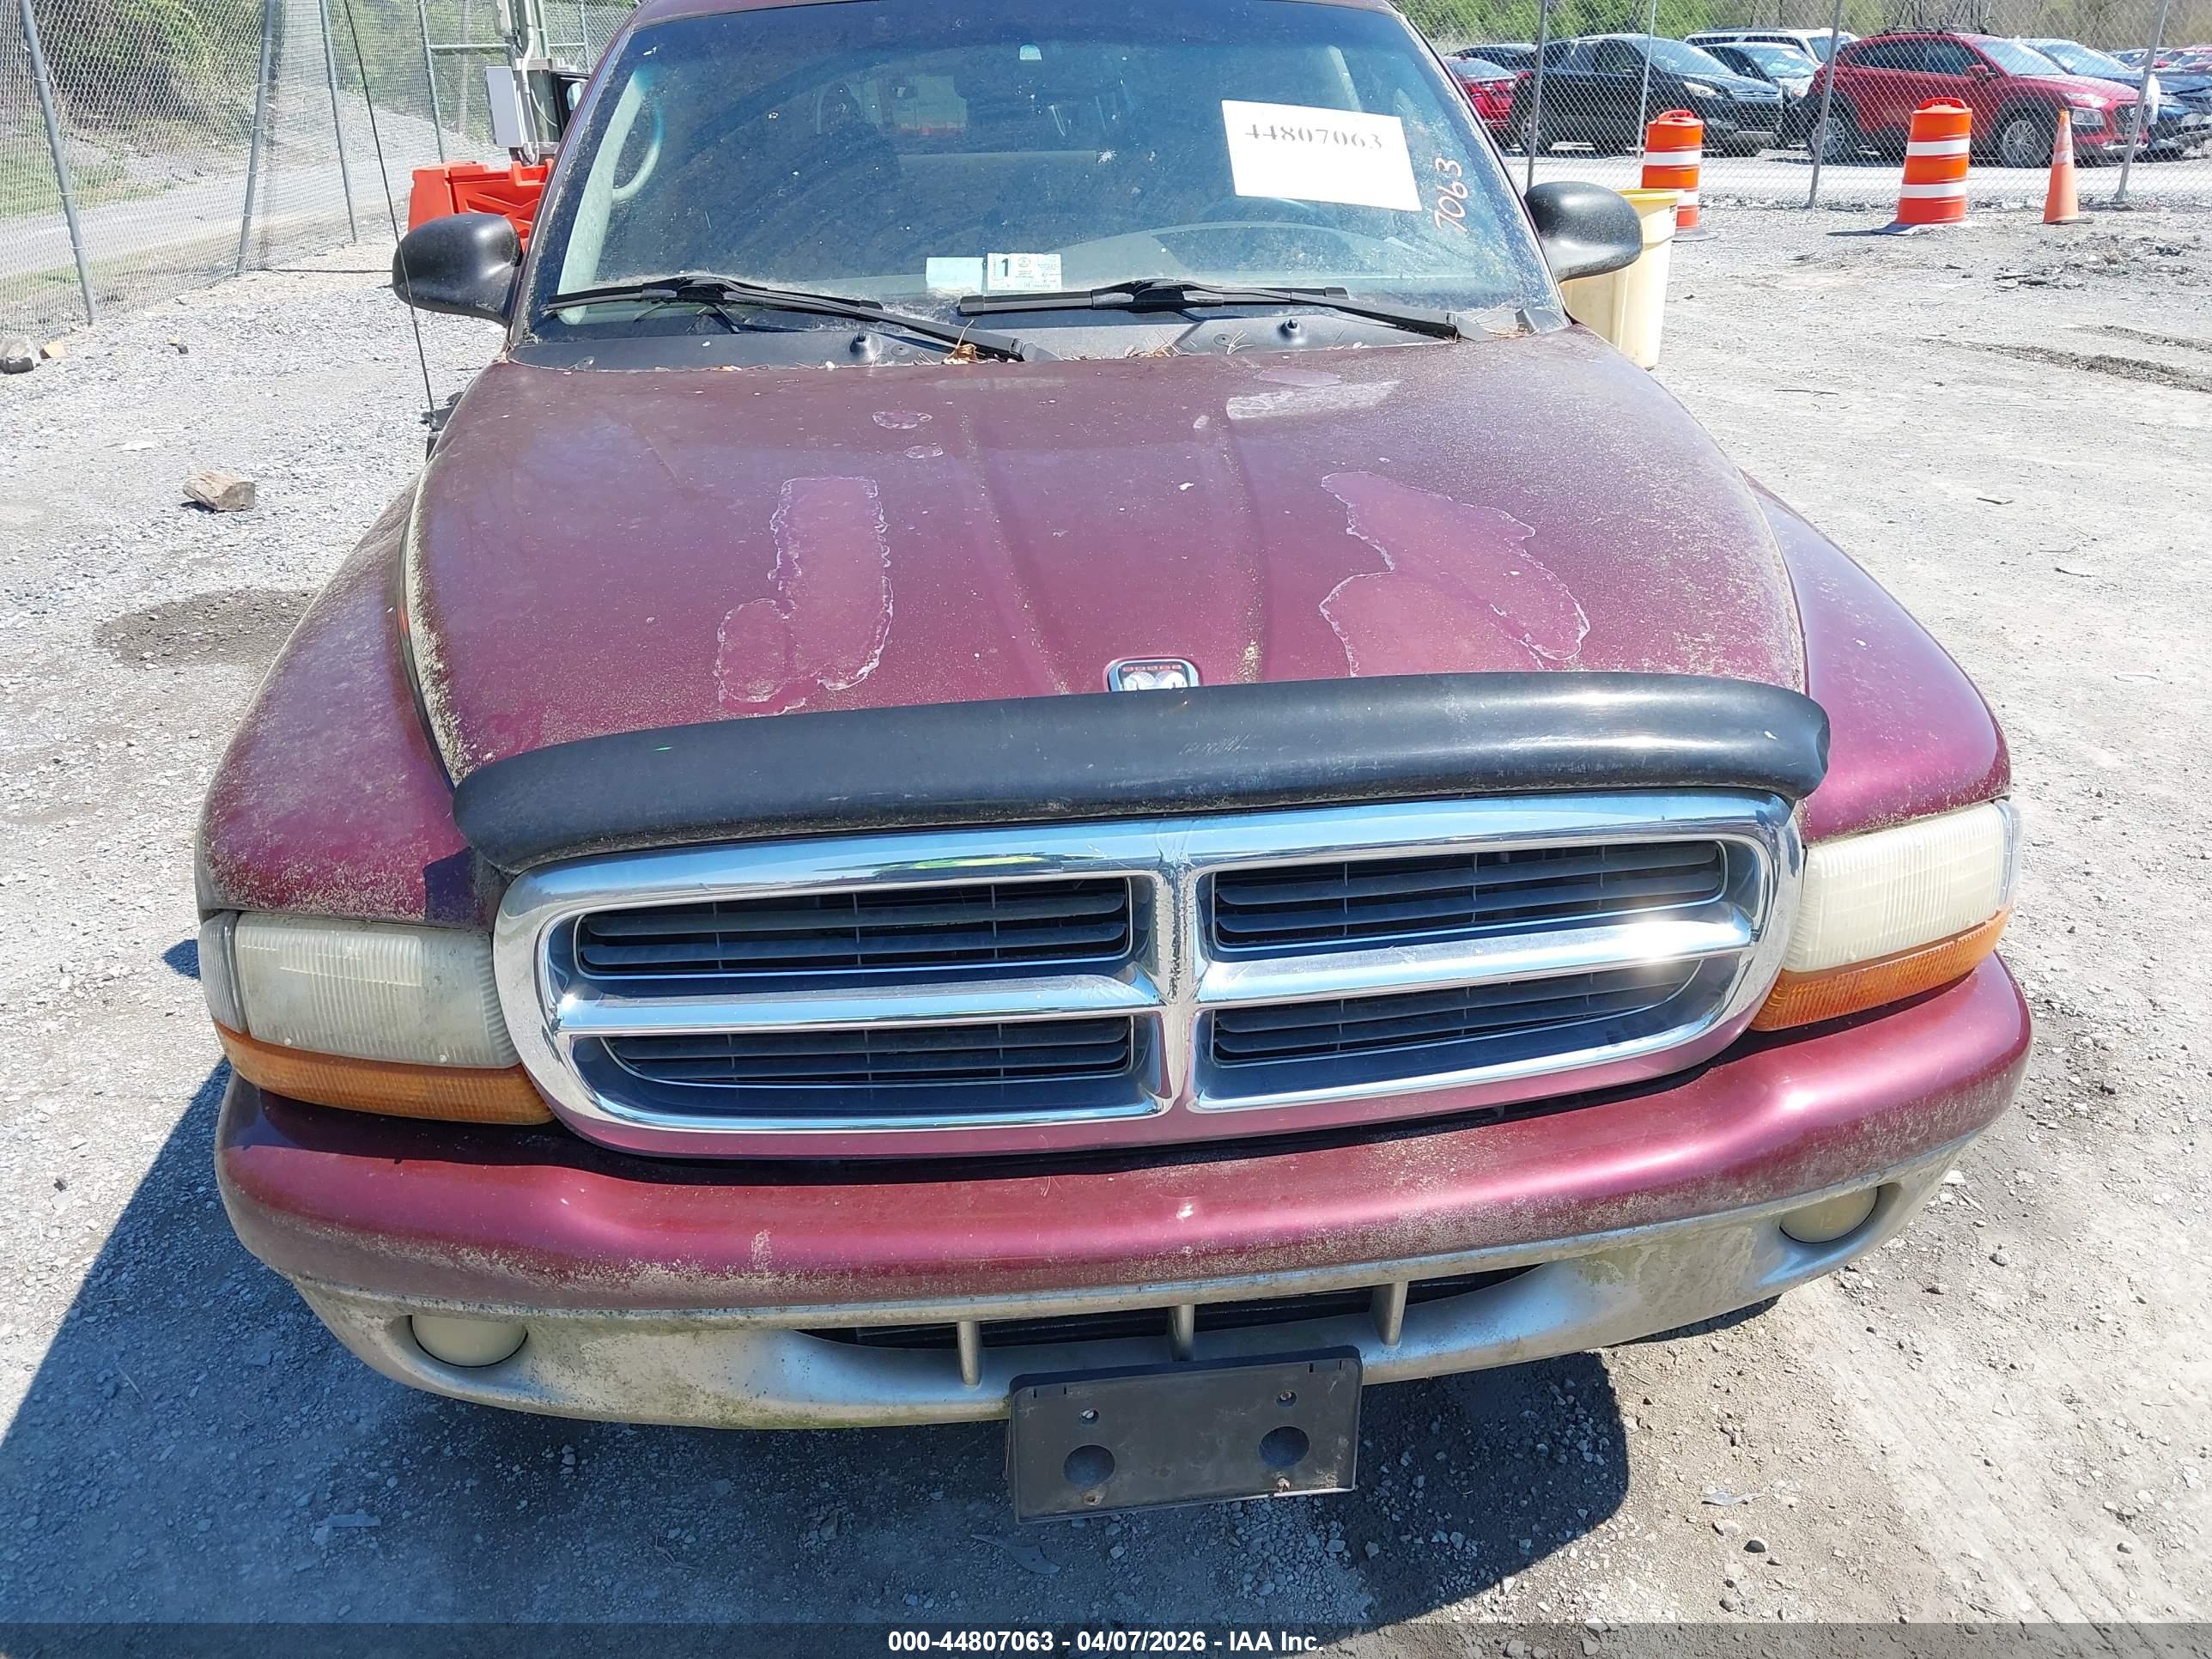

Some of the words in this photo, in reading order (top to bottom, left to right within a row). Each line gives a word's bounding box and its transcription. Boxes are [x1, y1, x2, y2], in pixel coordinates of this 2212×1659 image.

[1244, 124, 1382, 149] 44807063
[1431, 156, 1469, 234] 7063
[1001, 258, 1009, 277] 1
